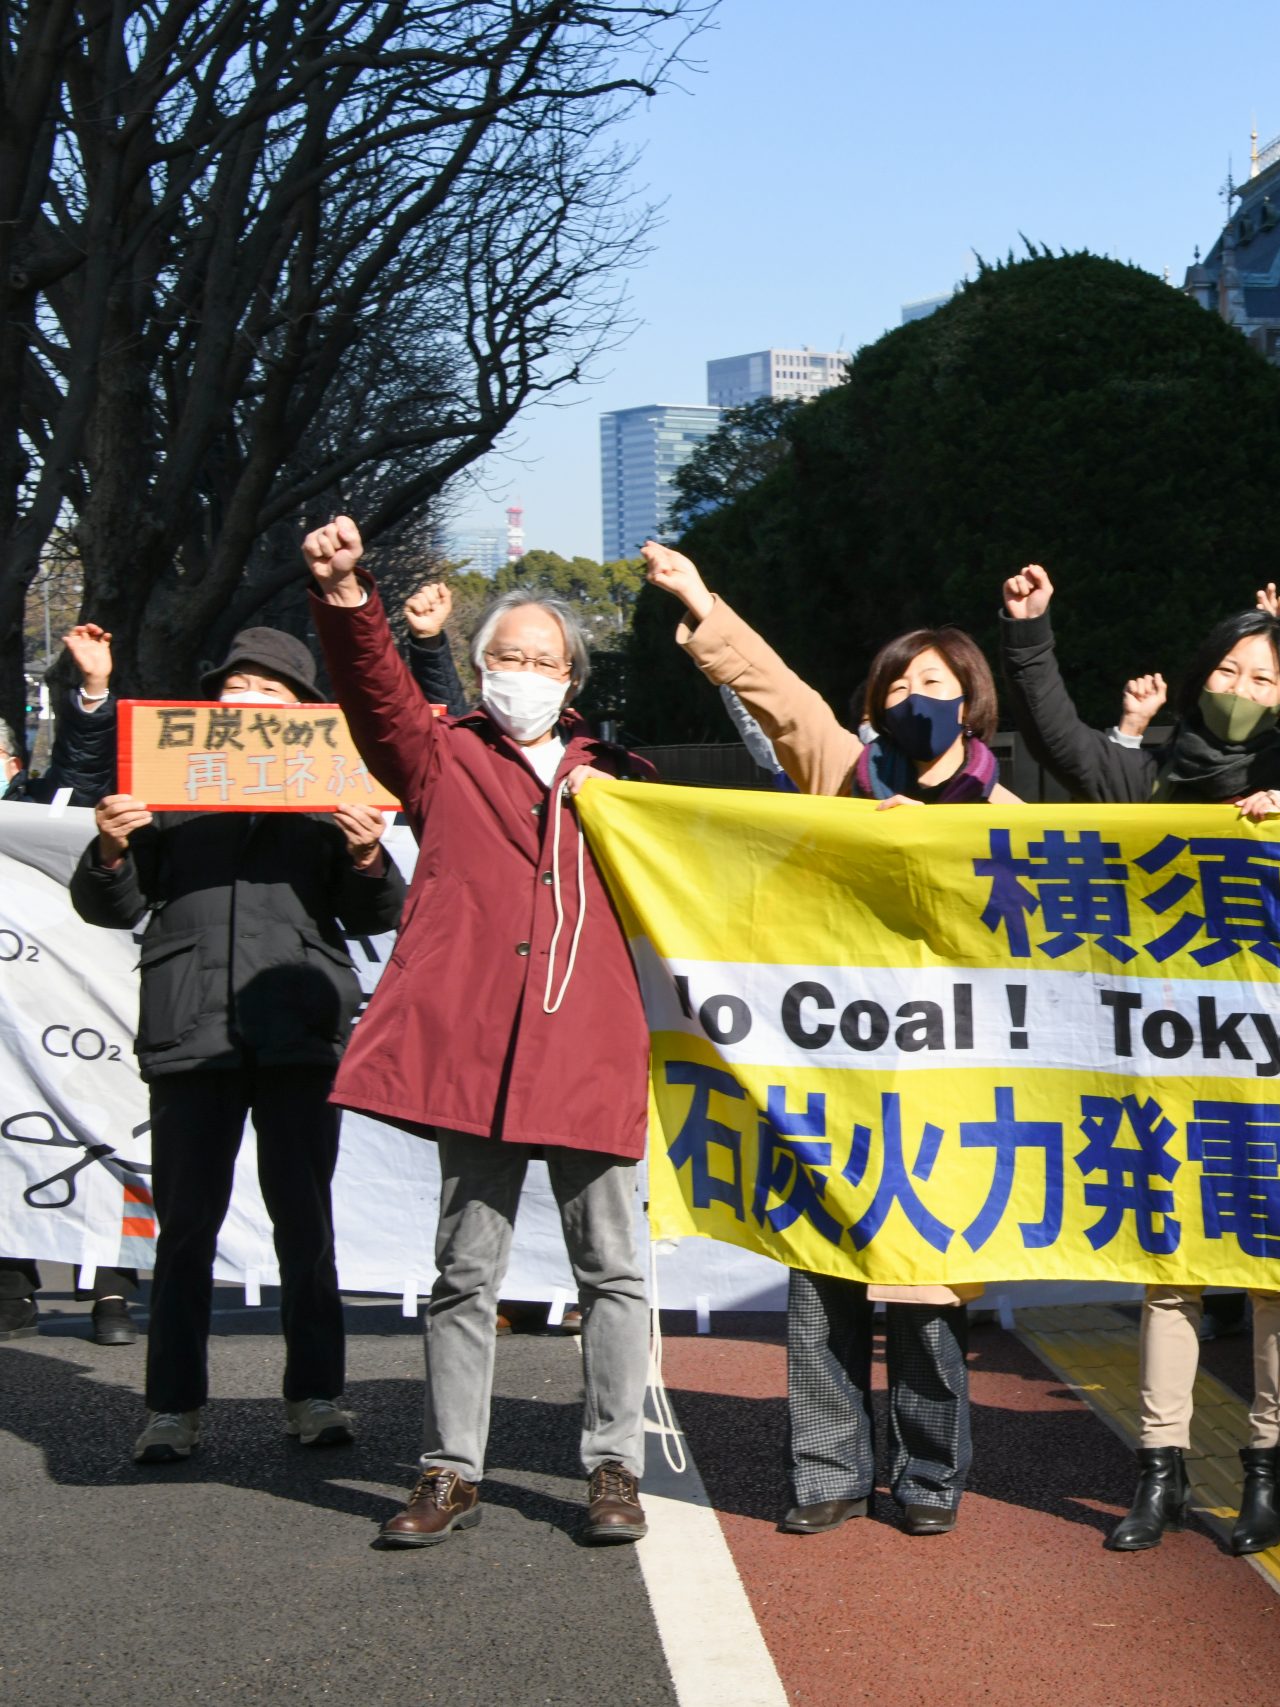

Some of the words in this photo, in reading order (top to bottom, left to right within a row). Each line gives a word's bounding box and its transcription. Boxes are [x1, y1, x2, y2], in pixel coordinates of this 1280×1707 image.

[156, 707, 339, 750] 石炭やめて
[672, 974, 752, 1045] o
